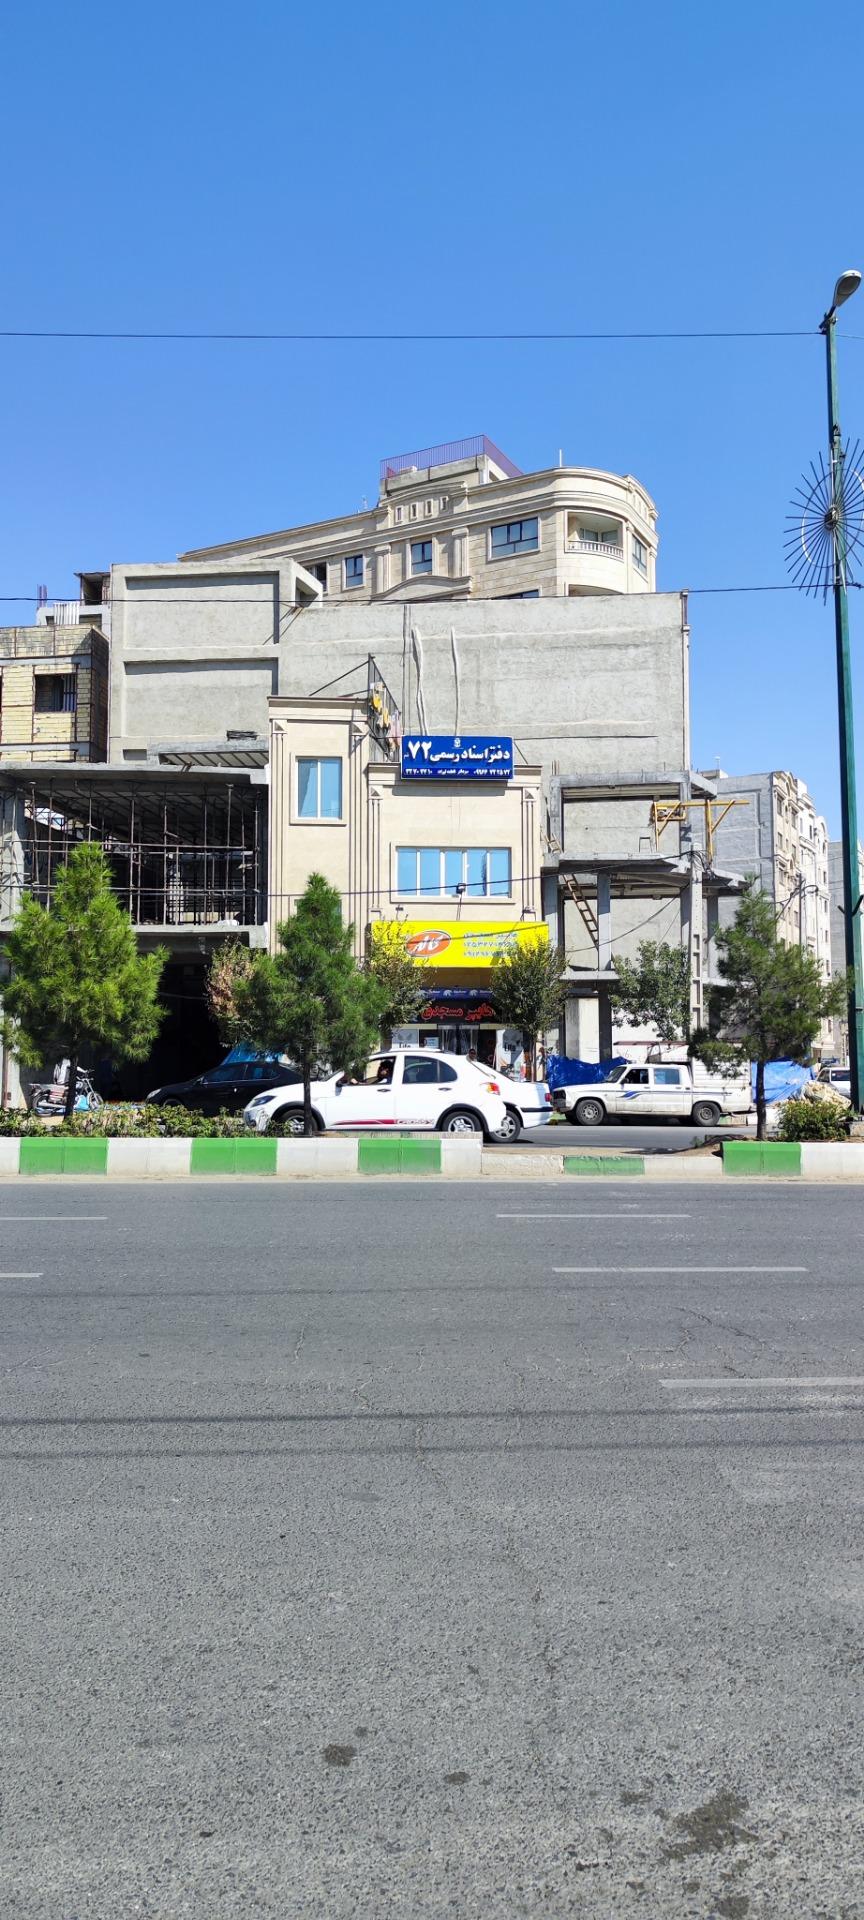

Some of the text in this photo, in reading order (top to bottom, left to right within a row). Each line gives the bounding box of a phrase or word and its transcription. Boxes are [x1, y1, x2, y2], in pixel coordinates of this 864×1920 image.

[407, 740, 432, 760] ۷۲
[429, 751, 460, 762] رسمی
[461, 744, 488, 760] اسناد
[487, 744, 511, 763] دفتر
[421, 1005, 464, 1020] مسجدی
